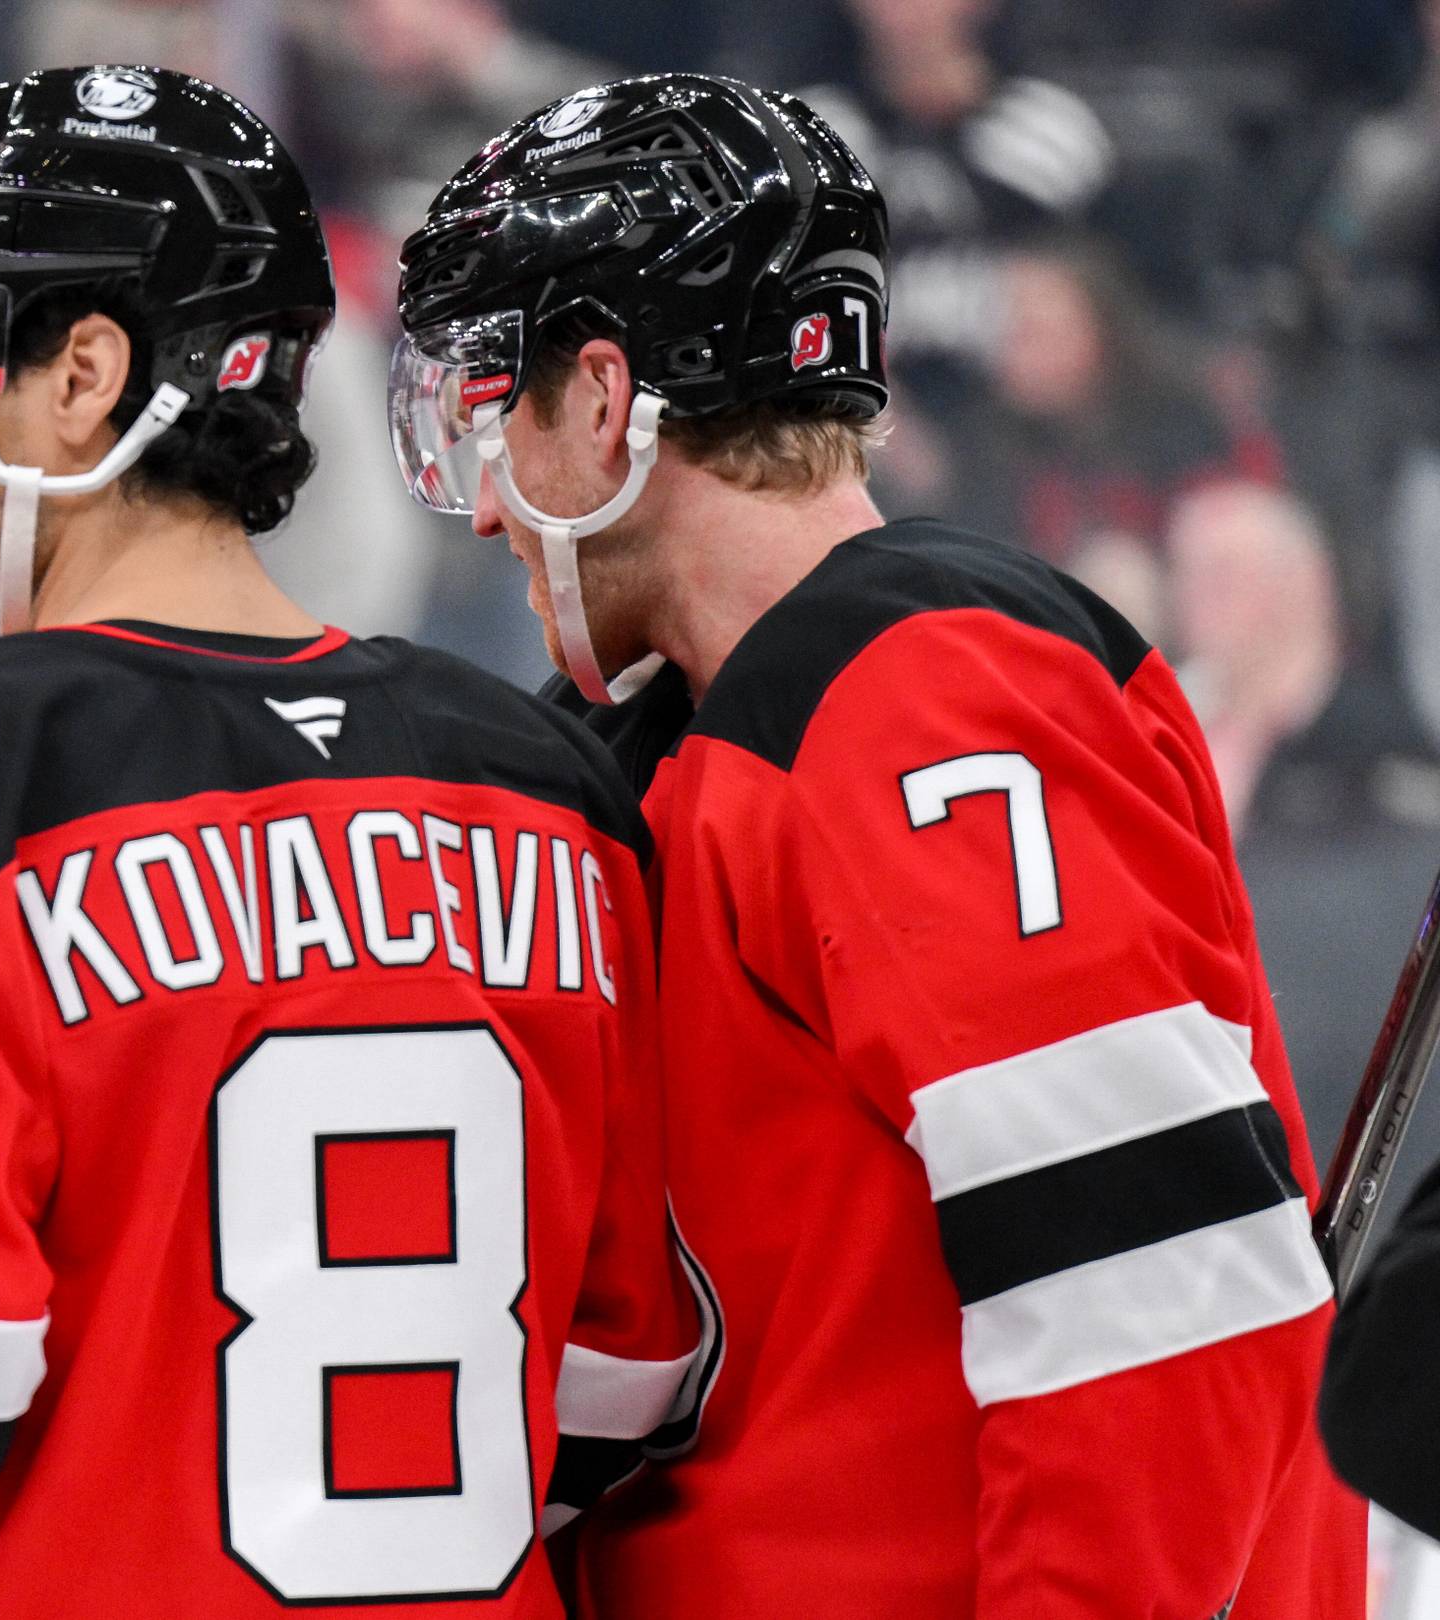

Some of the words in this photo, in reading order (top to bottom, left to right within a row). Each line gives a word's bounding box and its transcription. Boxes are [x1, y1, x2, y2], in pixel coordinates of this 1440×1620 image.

[524, 127, 602, 163] Prudential
[843, 296, 869, 371] 7
[16, 810, 617, 1026] KOVACEVIC
[898, 750, 1064, 939] 7
[210, 1018, 535, 1606] 8
